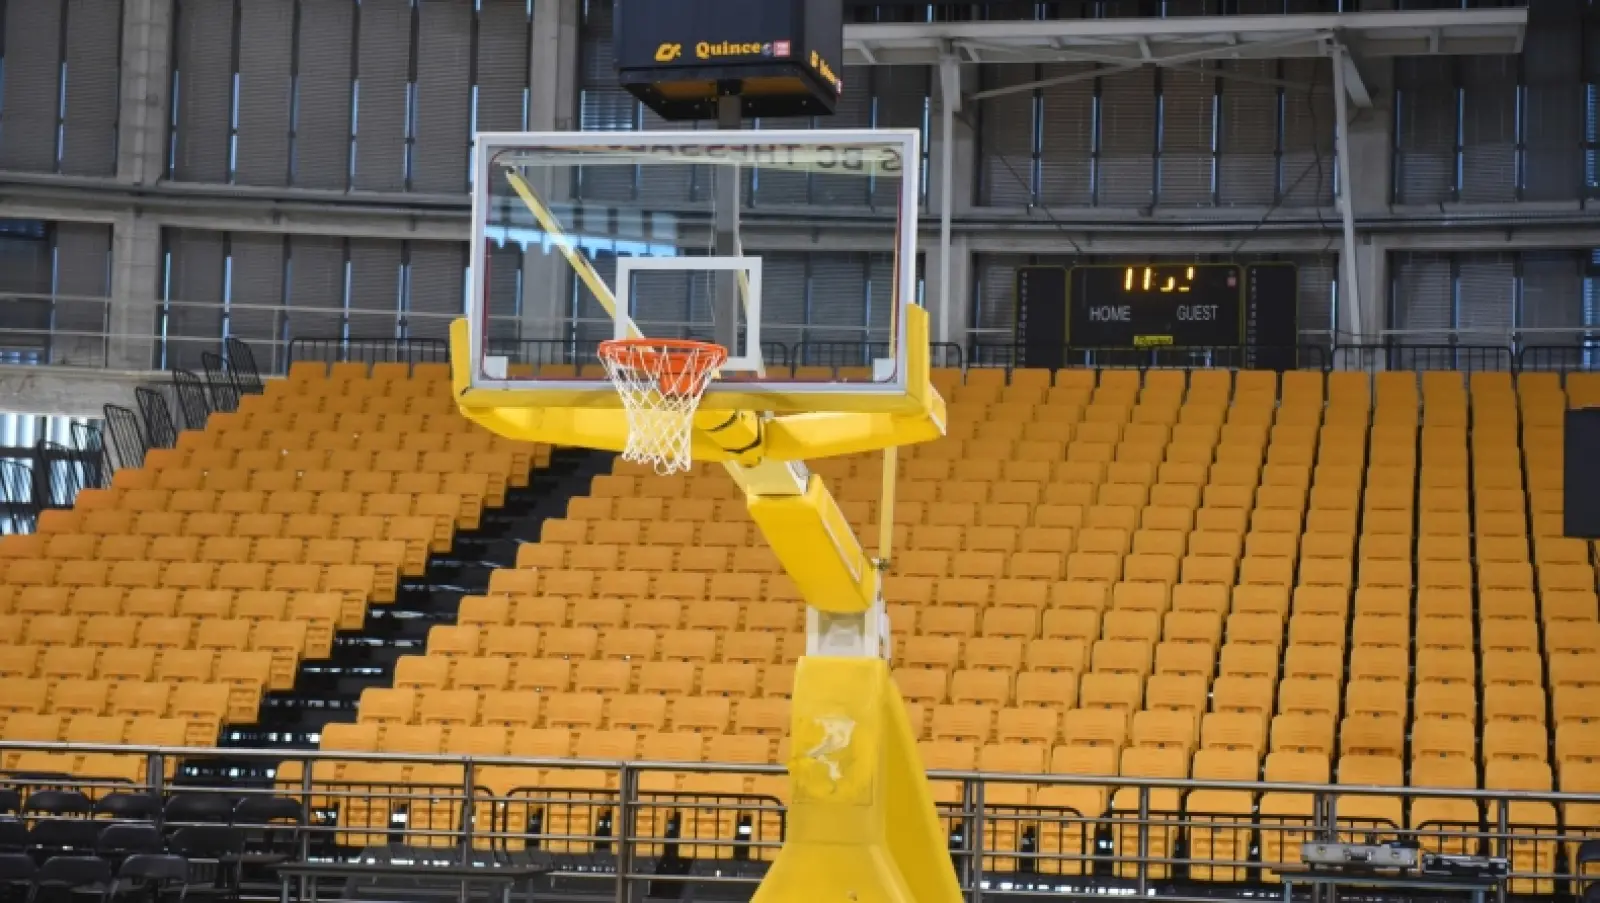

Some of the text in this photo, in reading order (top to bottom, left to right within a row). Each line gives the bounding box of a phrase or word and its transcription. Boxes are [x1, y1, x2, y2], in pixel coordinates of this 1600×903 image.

[695, 40, 761, 60] Quince
[1089, 305, 1131, 322] HOME
[1177, 304, 1219, 321] GUEST
